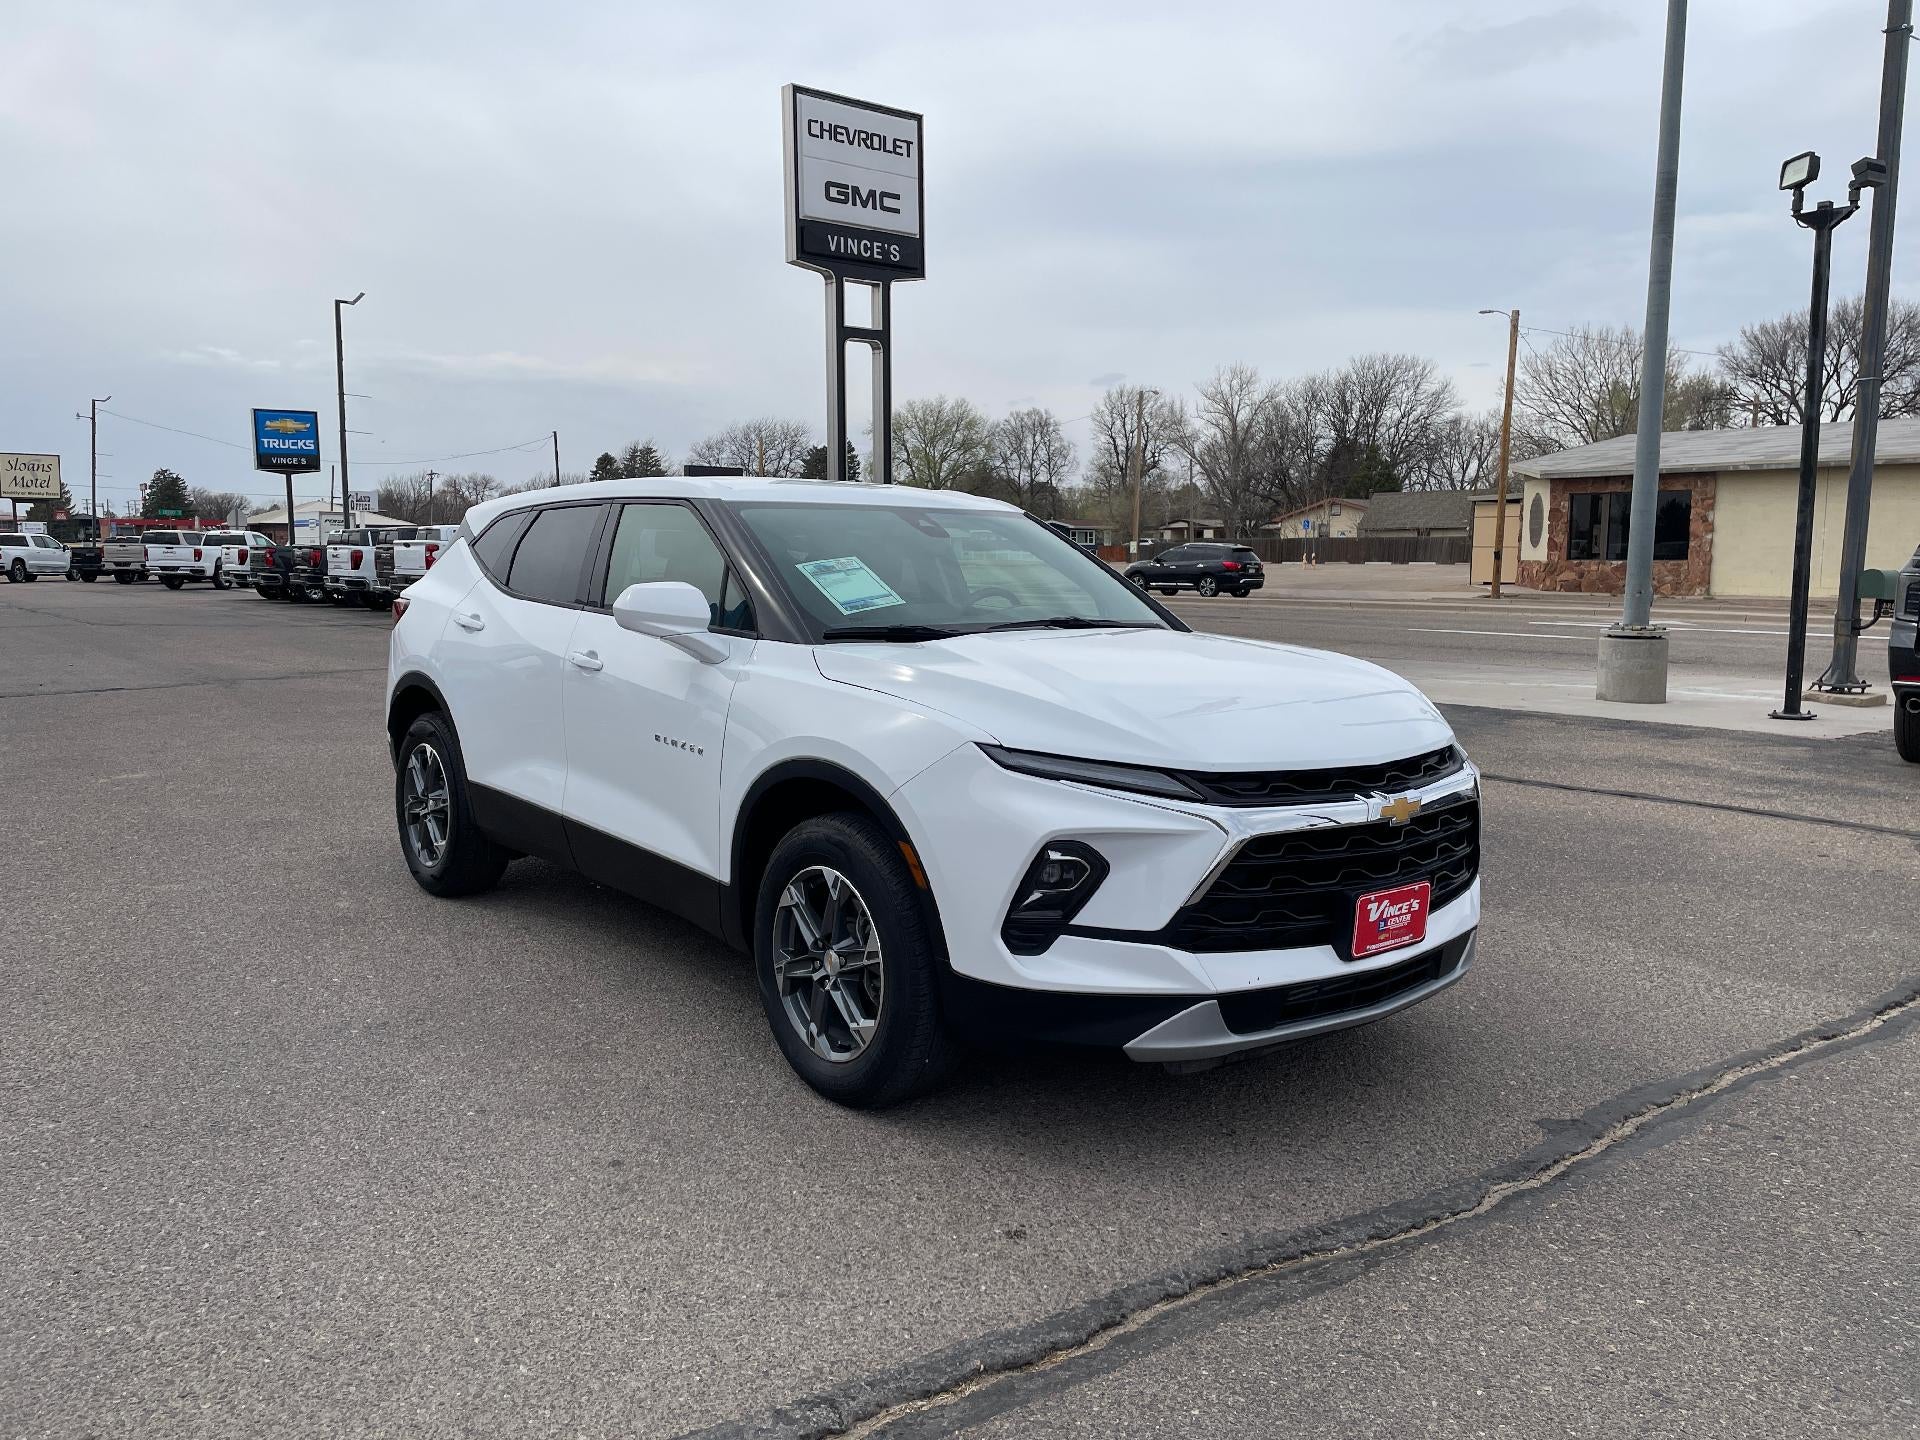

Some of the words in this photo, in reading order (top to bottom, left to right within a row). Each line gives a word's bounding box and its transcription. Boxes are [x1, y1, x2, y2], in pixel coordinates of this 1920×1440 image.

[807, 118, 914, 158] CHEVROLET
[824, 180, 901, 214] GMC
[827, 234, 900, 262] VINCE'S
[260, 438, 315, 450] TRUCKS
[5, 457, 53, 473] Sloans
[271, 456, 307, 465] VINCE'S
[8, 474, 51, 489] Motel
[654, 734, 704, 757] BLAZER
[1387, 913, 1411, 926] CENTER
